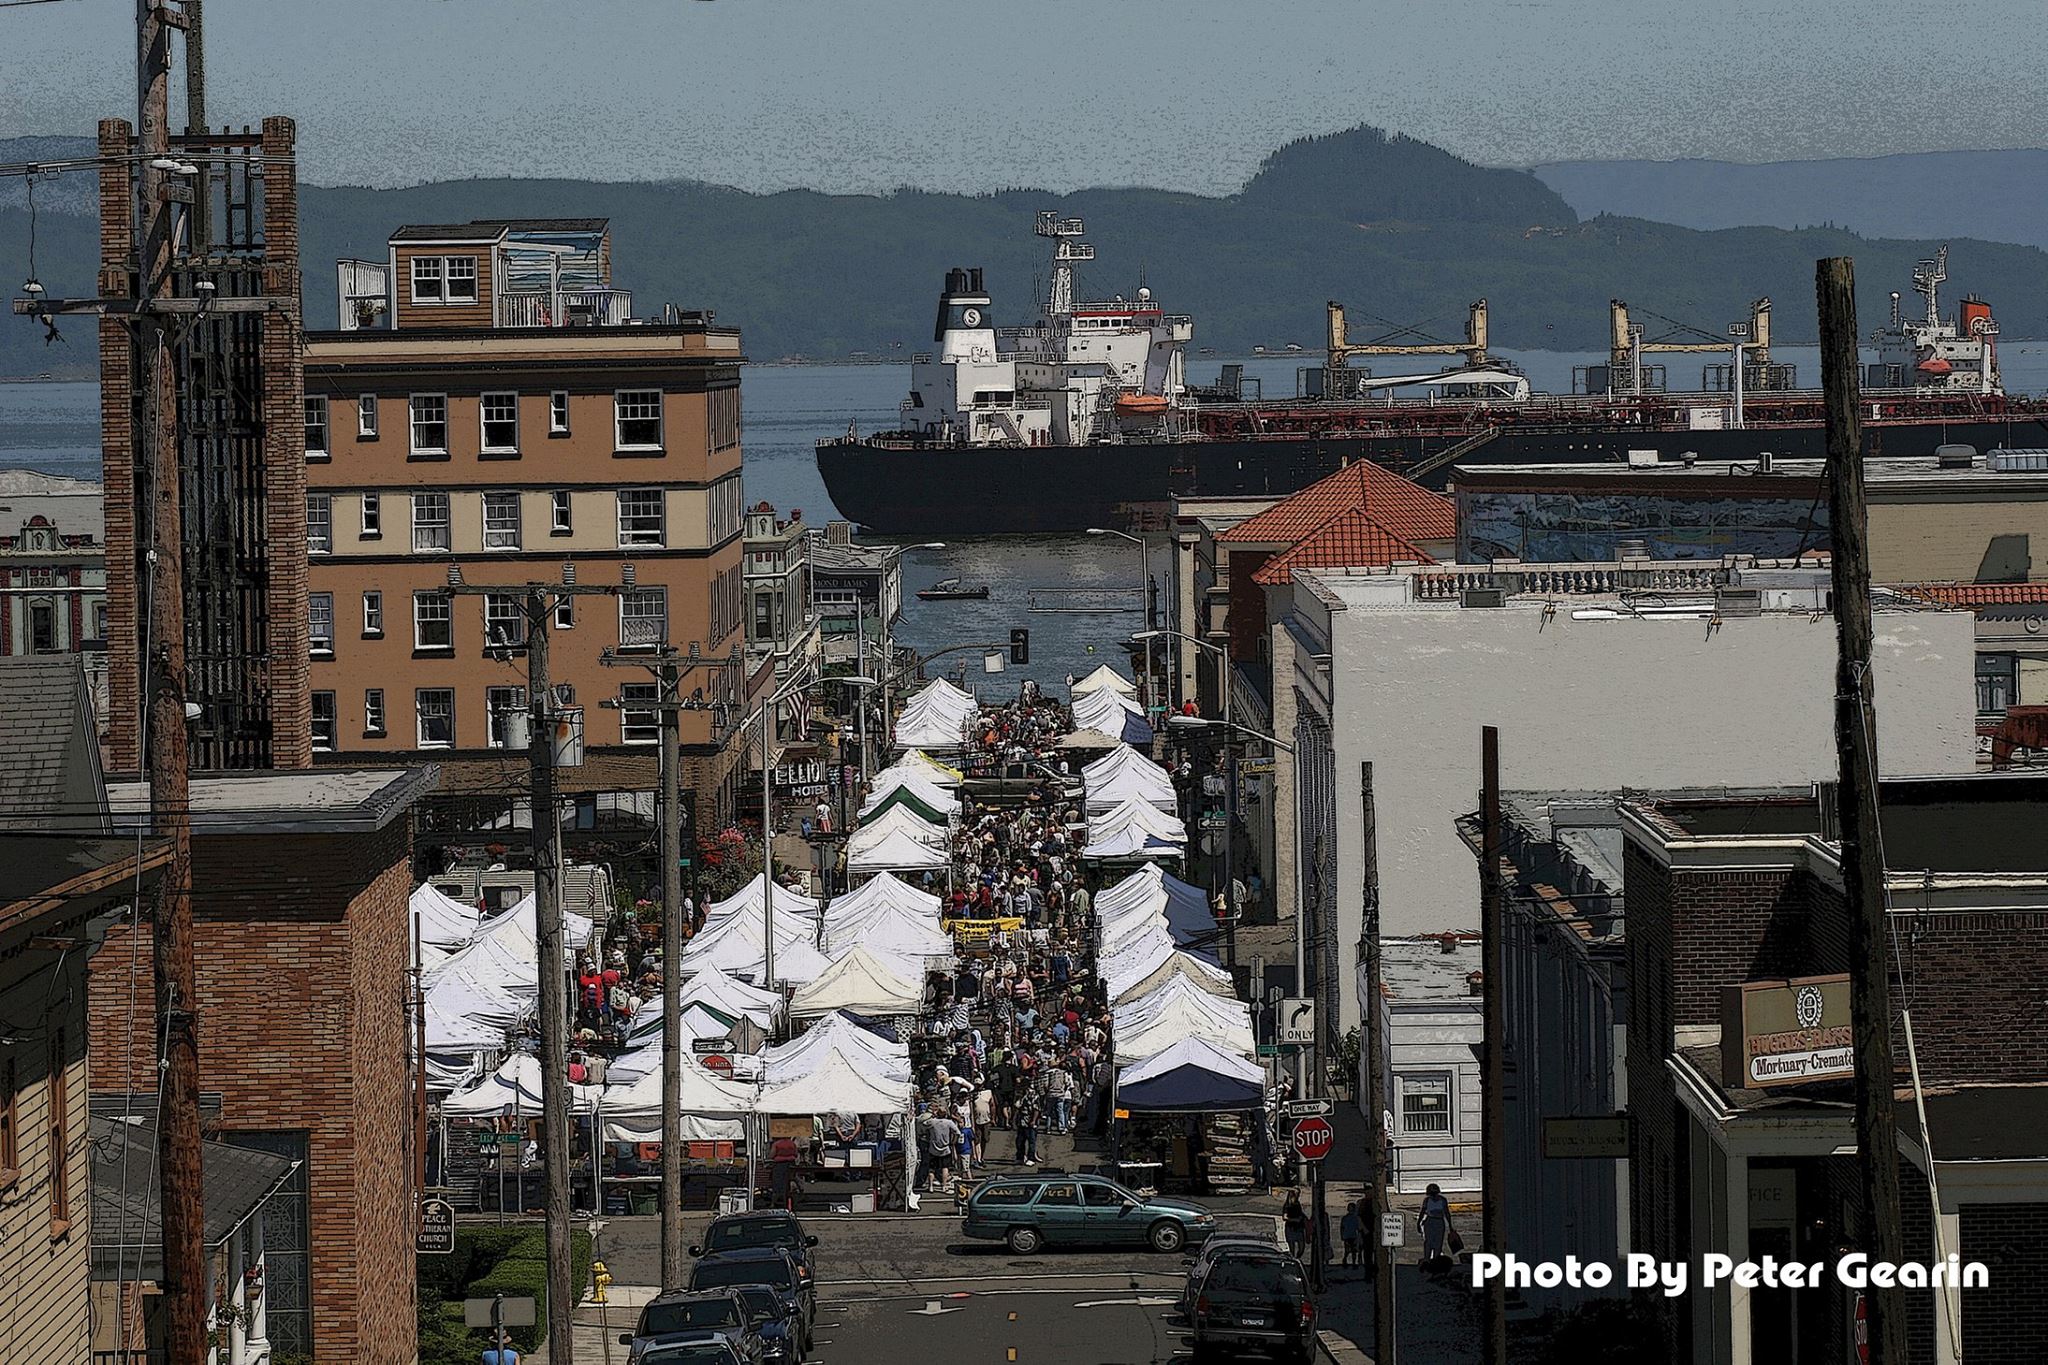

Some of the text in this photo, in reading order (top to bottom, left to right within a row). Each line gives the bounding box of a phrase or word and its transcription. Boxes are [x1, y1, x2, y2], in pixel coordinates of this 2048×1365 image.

[967, 311, 977, 324] S
[29, 577, 51, 586] 1923
[1287, 1030, 1314, 1041] ONLY
[1293, 1104, 1320, 1113] ONE WAY
[1296, 1130, 1330, 1148] STOP
[421, 1214, 447, 1223] PEACE
[418, 1234, 448, 1243] CHURCH
